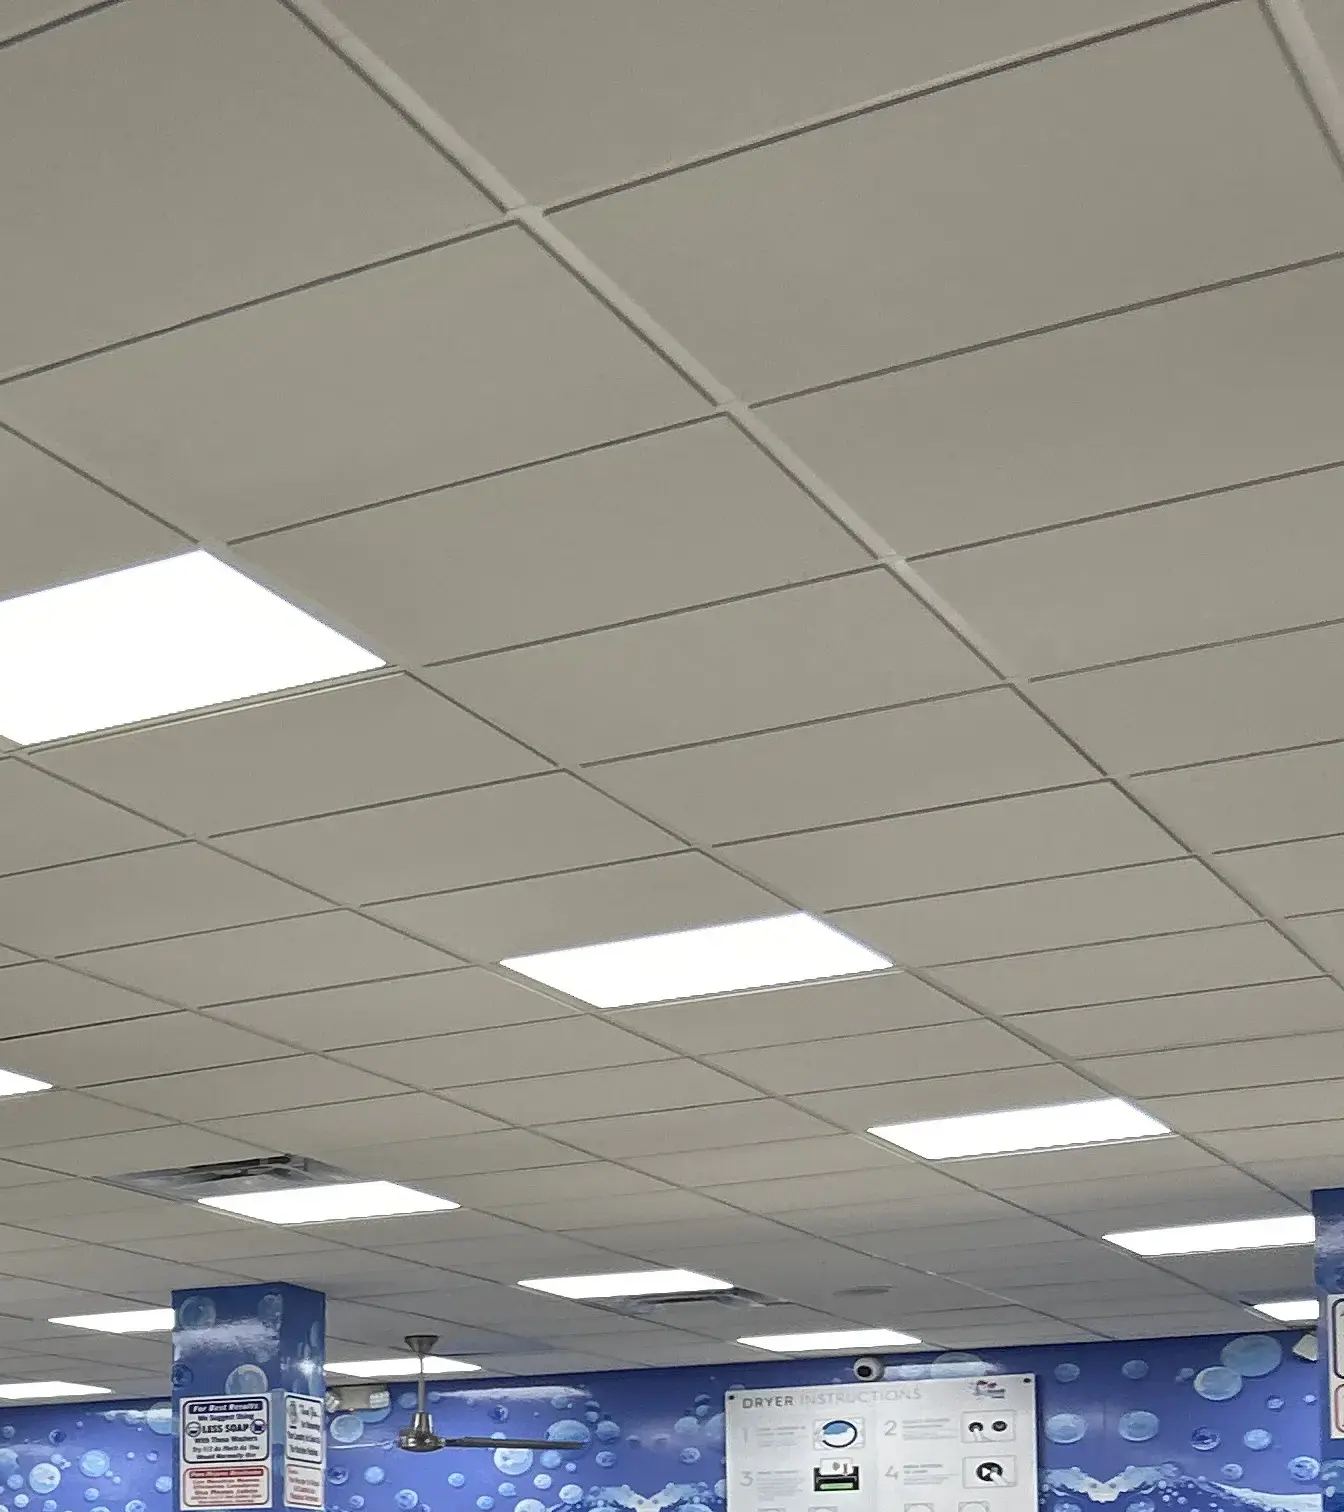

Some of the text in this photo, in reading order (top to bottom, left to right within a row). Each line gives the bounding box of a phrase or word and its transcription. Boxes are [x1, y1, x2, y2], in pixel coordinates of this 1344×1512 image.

[742, 1387, 921, 1409] DRYER INSTRUCTIONS
[202, 1424, 249, 1433] LESS SOAP
[884, 1420, 897, 1436] 2
[740, 1471, 753, 1487] 3
[885, 1466, 898, 1481] 4
